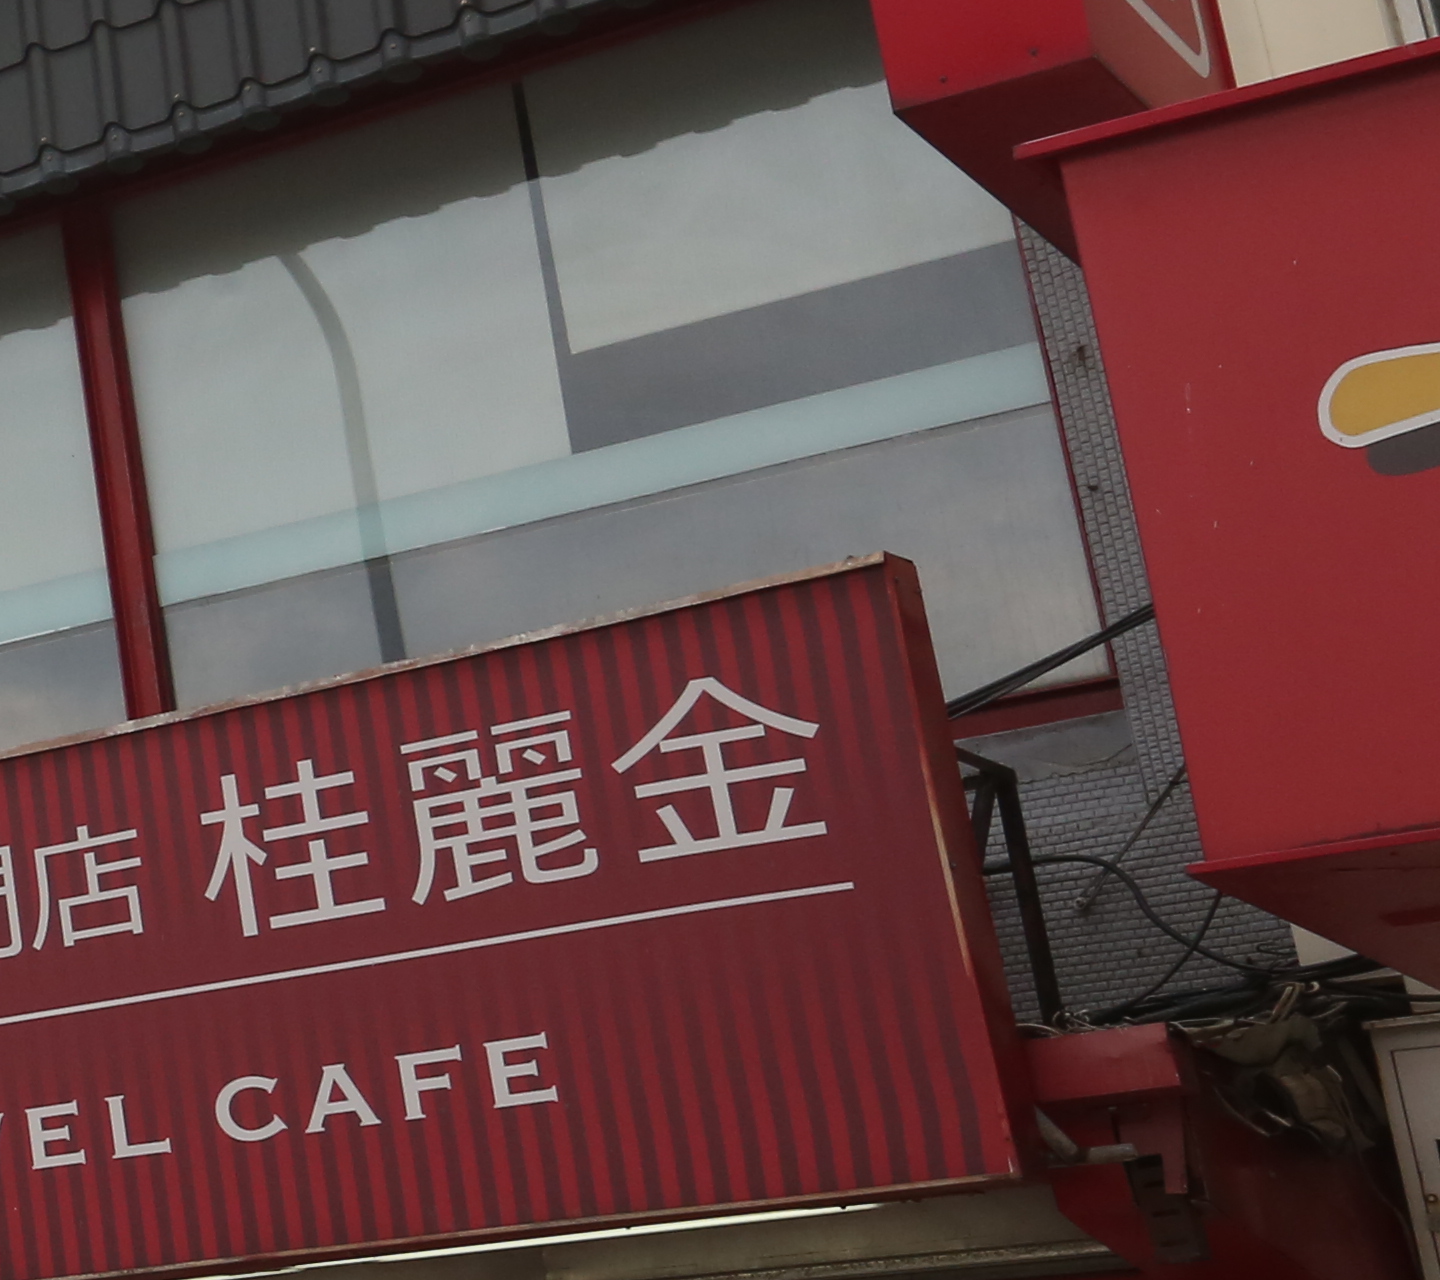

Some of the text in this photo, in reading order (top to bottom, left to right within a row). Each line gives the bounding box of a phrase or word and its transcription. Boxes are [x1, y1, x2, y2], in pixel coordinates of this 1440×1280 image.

[199, 676, 828, 937] 桂麗金
[215, 1030, 558, 1142] CAFE
